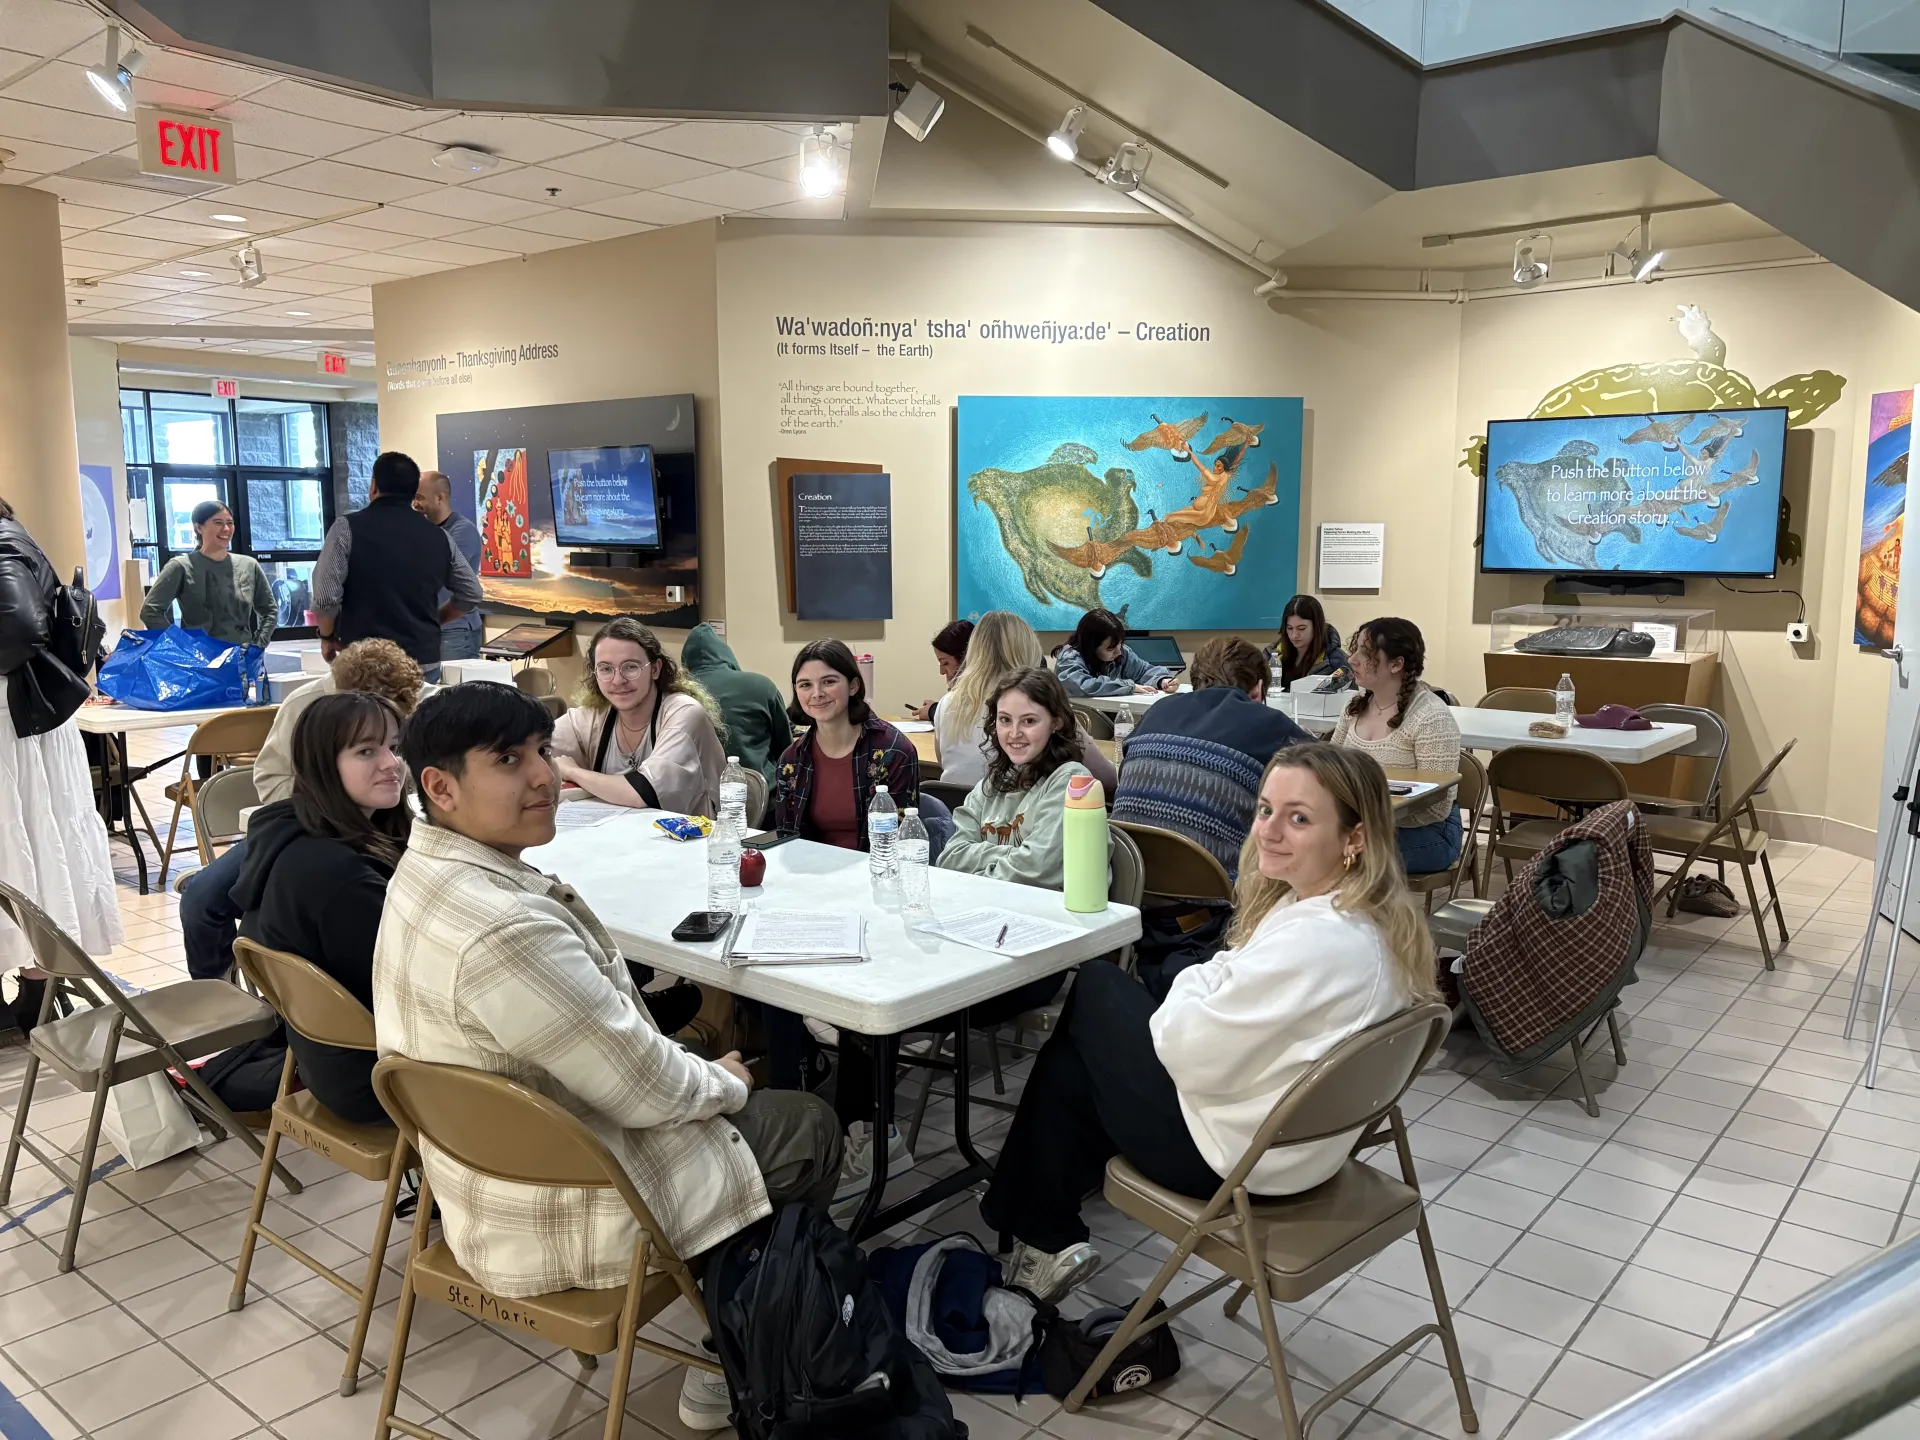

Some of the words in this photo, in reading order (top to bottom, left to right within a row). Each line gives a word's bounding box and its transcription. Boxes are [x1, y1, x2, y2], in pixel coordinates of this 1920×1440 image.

[158, 120, 221, 173] EXIT
[775, 316, 917, 341] Wa'wadoñ:nya'
[926, 318, 972, 339] tsha'
[979, 319, 1111, 344] oñhweñjya:de'
[1135, 321, 1210, 342] Creation
[456, 347, 517, 369] Thanksgiving
[518, 343, 559, 361] Address
[776, 342, 790, 358] (It
[791, 342, 827, 356] forms
[829, 342, 859, 356] Itself
[876, 343, 897, 357] the
[898, 343, 934, 360] Earth)
[324, 354, 346, 375] EXIT
[217, 380, 237, 396] EXIT
[387, 380, 406, 393] (Words
[405, 379, 417, 389] that
[432, 375, 450, 387] before
[450, 374, 458, 385] all
[458, 372, 473, 385] else)
[795, 380, 824, 396] things
[843, 381, 874, 392] bound
[875, 381, 919, 396] together,
[780, 392, 791, 404] all
[793, 392, 822, 407] things
[823, 396, 864, 405] connect.
[866, 394, 909, 405] Whatever
[910, 394, 941, 406] befalls
[780, 404, 797, 416] the
[798, 405, 827, 418] earth,
[828, 405, 860, 417] befalls
[861, 405, 881, 417] also
[882, 406, 898, 417] the
[899, 406, 936, 418] children
[780, 416, 792, 428] of
[793, 416, 809, 428] the
[792, 428, 807, 436] Lyons
[1551, 458, 1583, 479] Push
[1586, 458, 1609, 479] the
[1612, 458, 1660, 478] button
[1663, 454, 1706, 477] below
[573, 474, 586, 488] Push
[586, 474, 595, 487] the
[594, 474, 612, 488] button
[612, 473, 628, 487] below
[573, 490, 580, 502] to
[579, 488, 593, 502] learn
[592, 493, 606, 502] more
[605, 488, 621, 502] about
[620, 488, 631, 501] the
[798, 493, 832, 501] Creation
[1546, 488, 1561, 502] to
[1563, 482, 1597, 503] learn
[1599, 490, 1634, 502] more
[1636, 481, 1681, 501] about
[1682, 479, 1708, 500] the
[1567, 509, 1627, 525] Creation
[1628, 508, 1680, 532] story...
[283, 1118, 299, 1139] Ste.
[303, 1128, 331, 1157] Marie
[446, 1284, 474, 1308] Ste.
[479, 1293, 540, 1332] Marie
